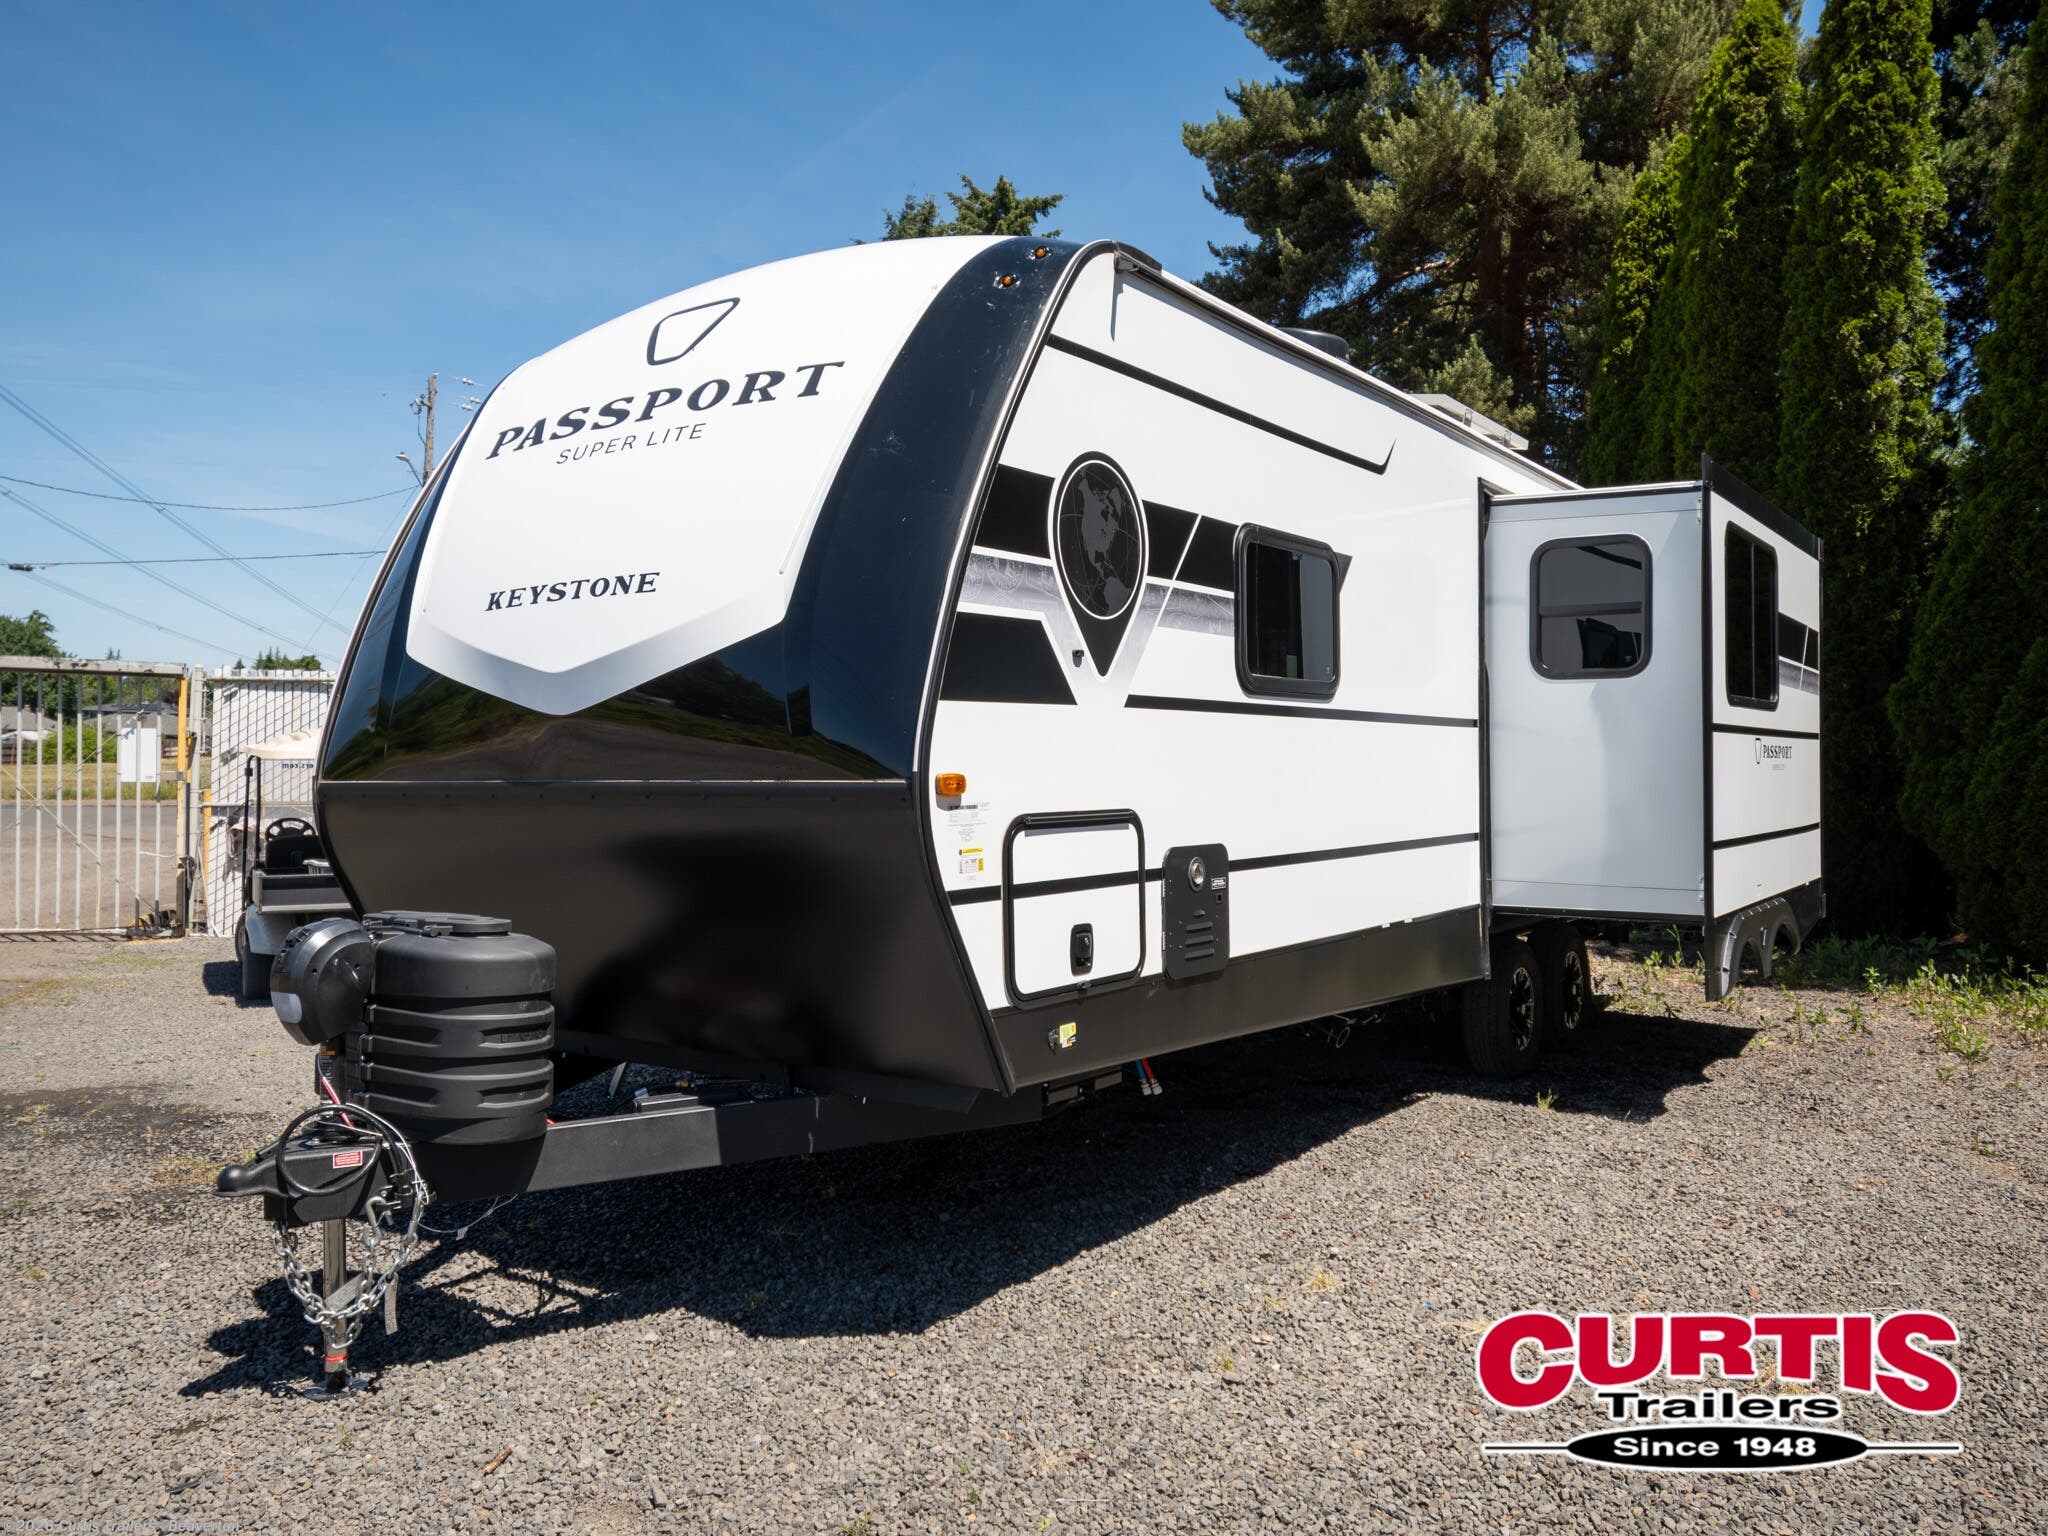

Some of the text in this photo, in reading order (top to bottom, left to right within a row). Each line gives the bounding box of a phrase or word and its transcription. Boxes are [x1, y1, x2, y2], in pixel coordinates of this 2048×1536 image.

[485, 361, 845, 460] PASSPORT
[556, 423, 707, 464] SUPER LITE
[485, 572, 660, 611] KEYSTONE
[1763, 745, 1792, 759] PASSPORT
